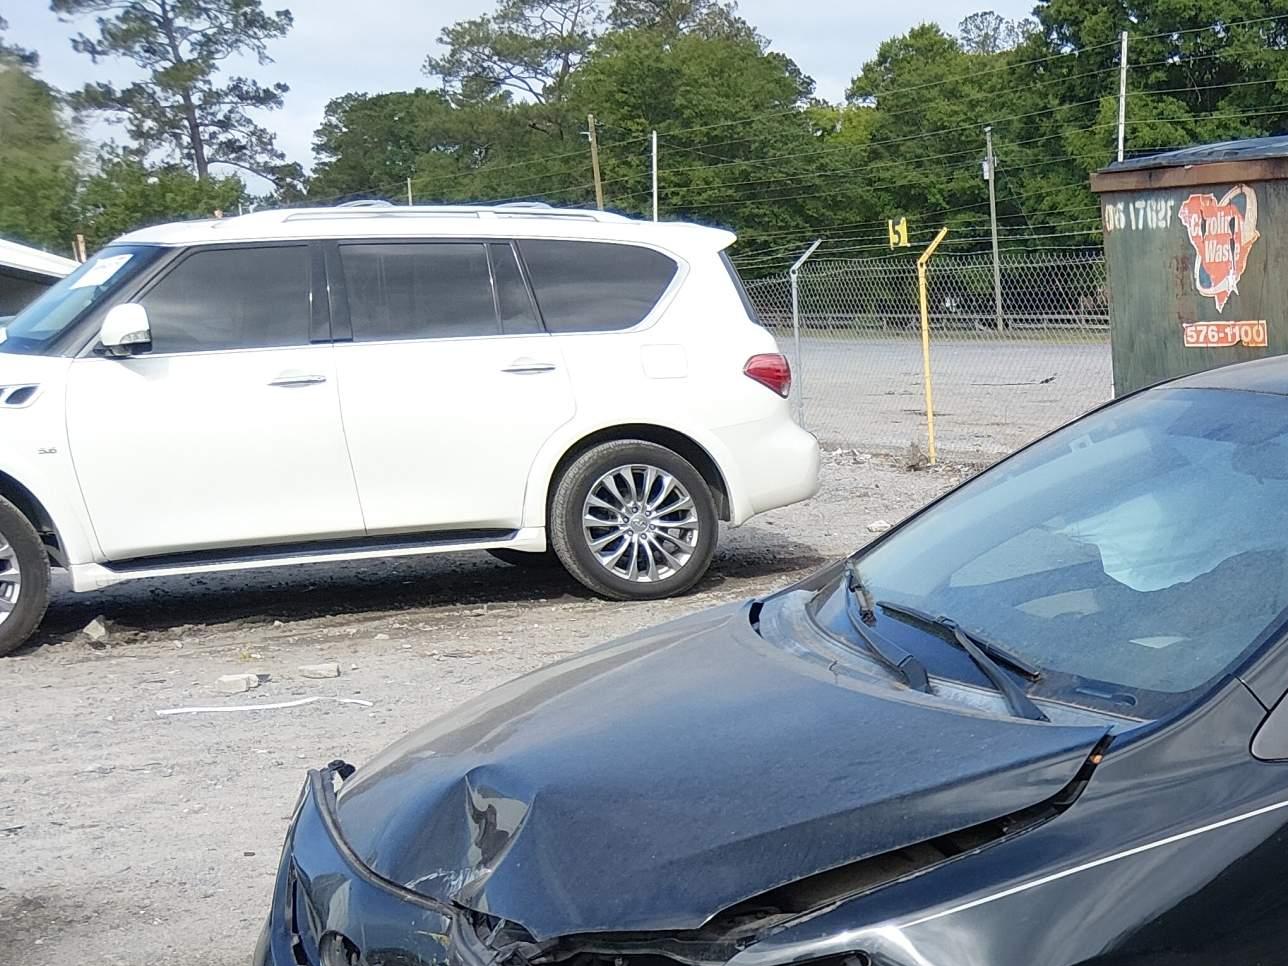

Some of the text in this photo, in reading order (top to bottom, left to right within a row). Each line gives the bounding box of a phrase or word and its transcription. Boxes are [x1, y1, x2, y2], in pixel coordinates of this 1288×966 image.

[892, 217, 902, 245] 5
[1205, 239, 1240, 263] Waste
[1187, 325, 1264, 343] 576-1100
